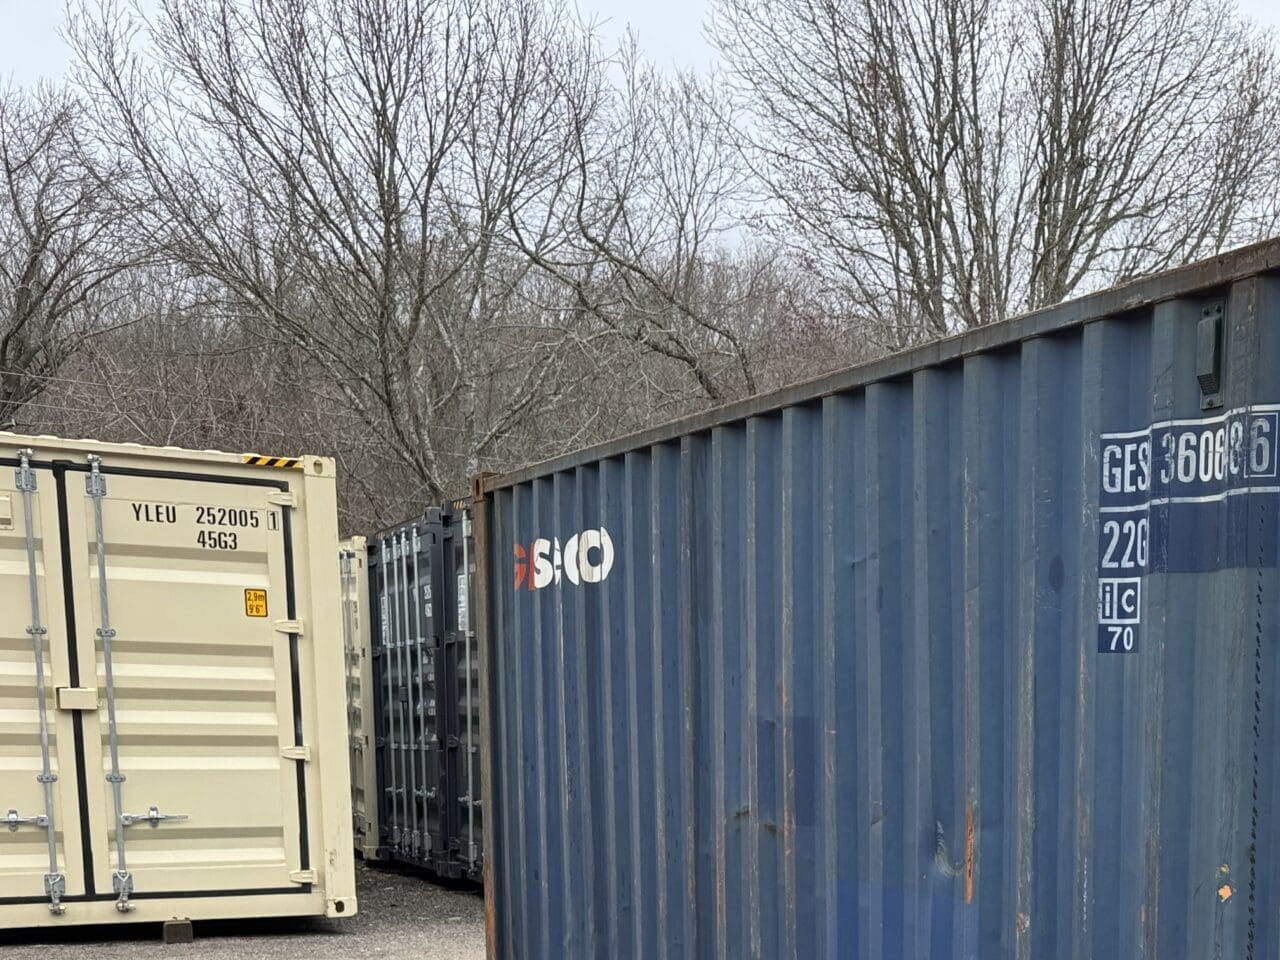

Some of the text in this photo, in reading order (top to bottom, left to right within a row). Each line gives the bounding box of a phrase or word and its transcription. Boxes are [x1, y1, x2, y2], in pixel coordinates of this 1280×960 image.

[1103, 443, 1150, 492] GES
[1249, 418, 1270, 472] 6
[132, 503, 176, 523] YLEU
[196, 506, 259, 528] 252005
[197, 530, 237, 550] 45G3
[1102, 519, 1149, 569] 22G
[1107, 626, 1134, 651] 70
